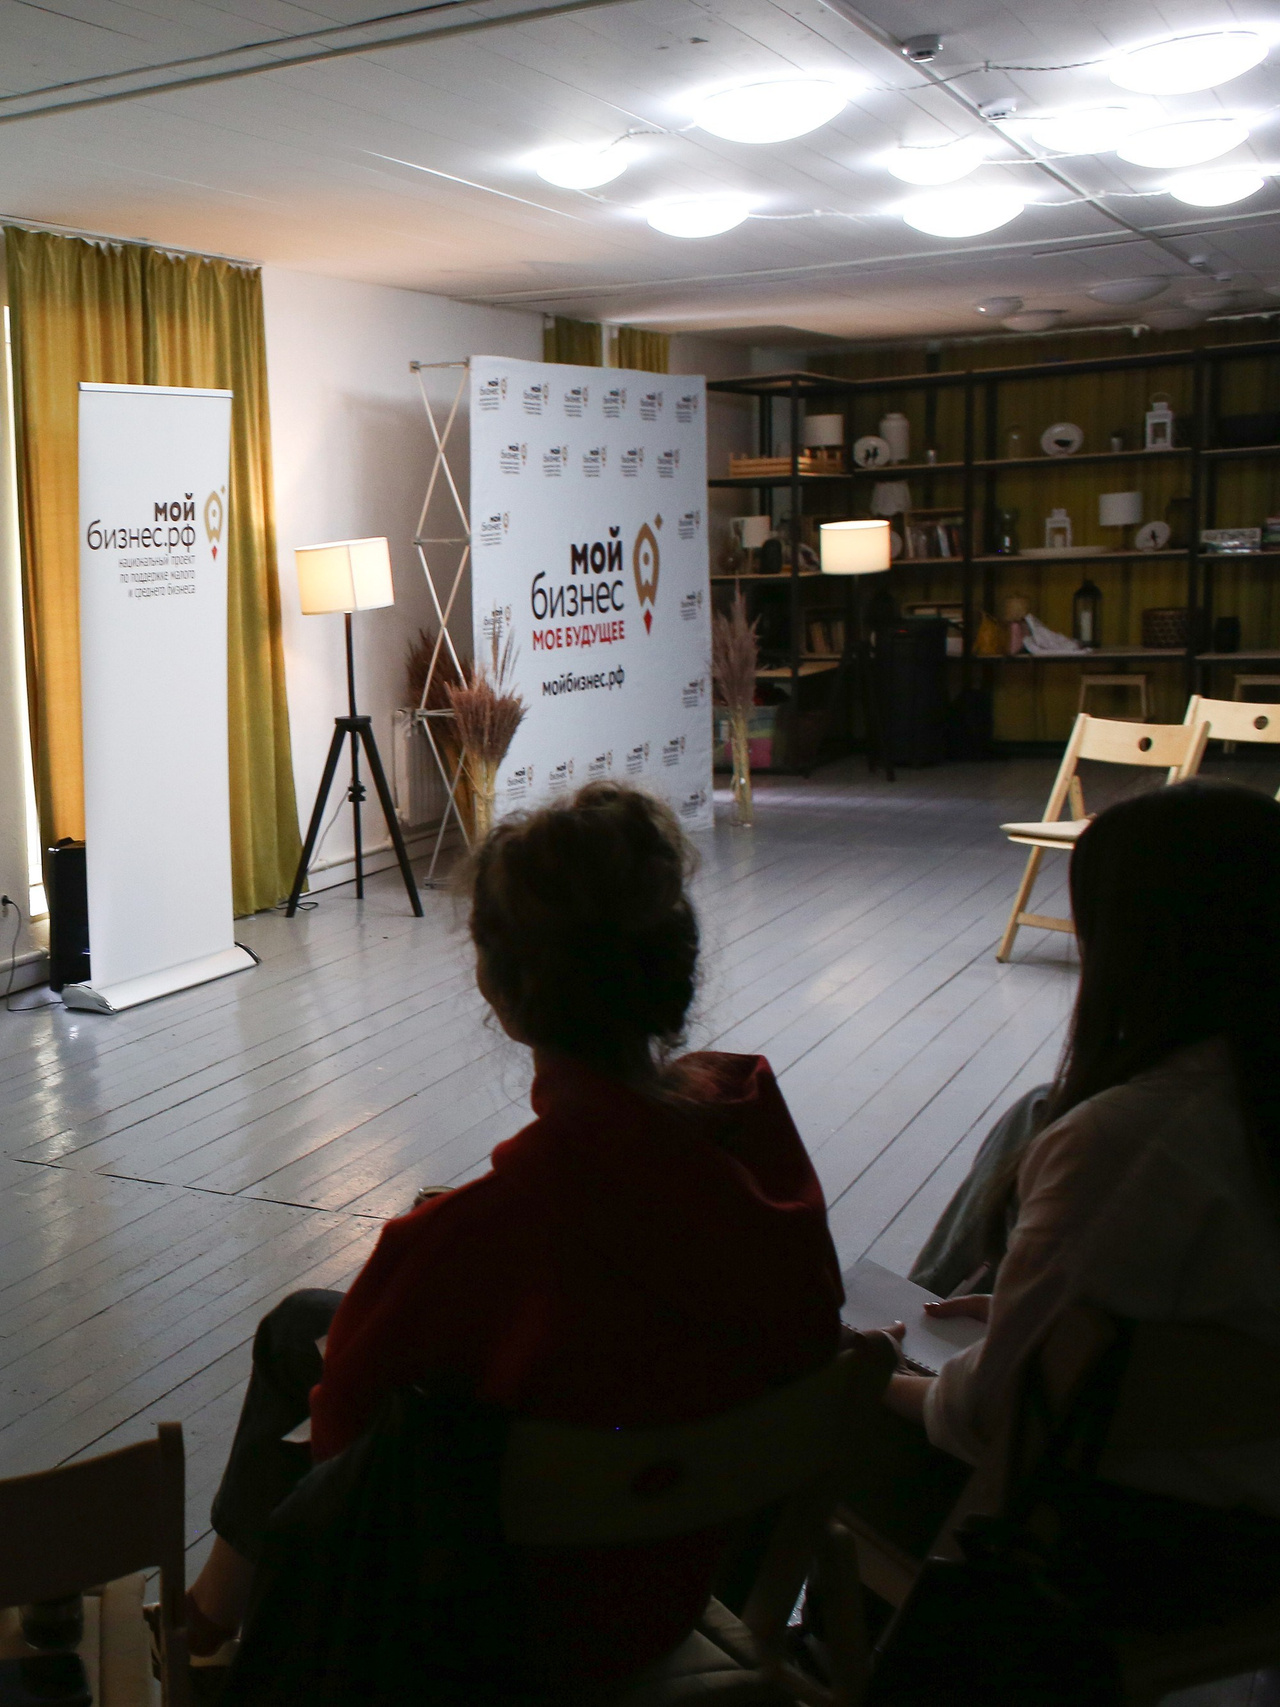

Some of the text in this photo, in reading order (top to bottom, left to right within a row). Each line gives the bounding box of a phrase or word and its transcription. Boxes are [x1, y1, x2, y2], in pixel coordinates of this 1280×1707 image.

[154, 492, 196, 522] мой
[86, 519, 197, 554] бизнес.рф
[570, 525, 623, 576] мой
[530, 571, 625, 620] бизнес
[532, 620, 625, 651] МОЕ БУДУЩЕЕ
[541, 664, 625, 696] мойбизнес.рф
